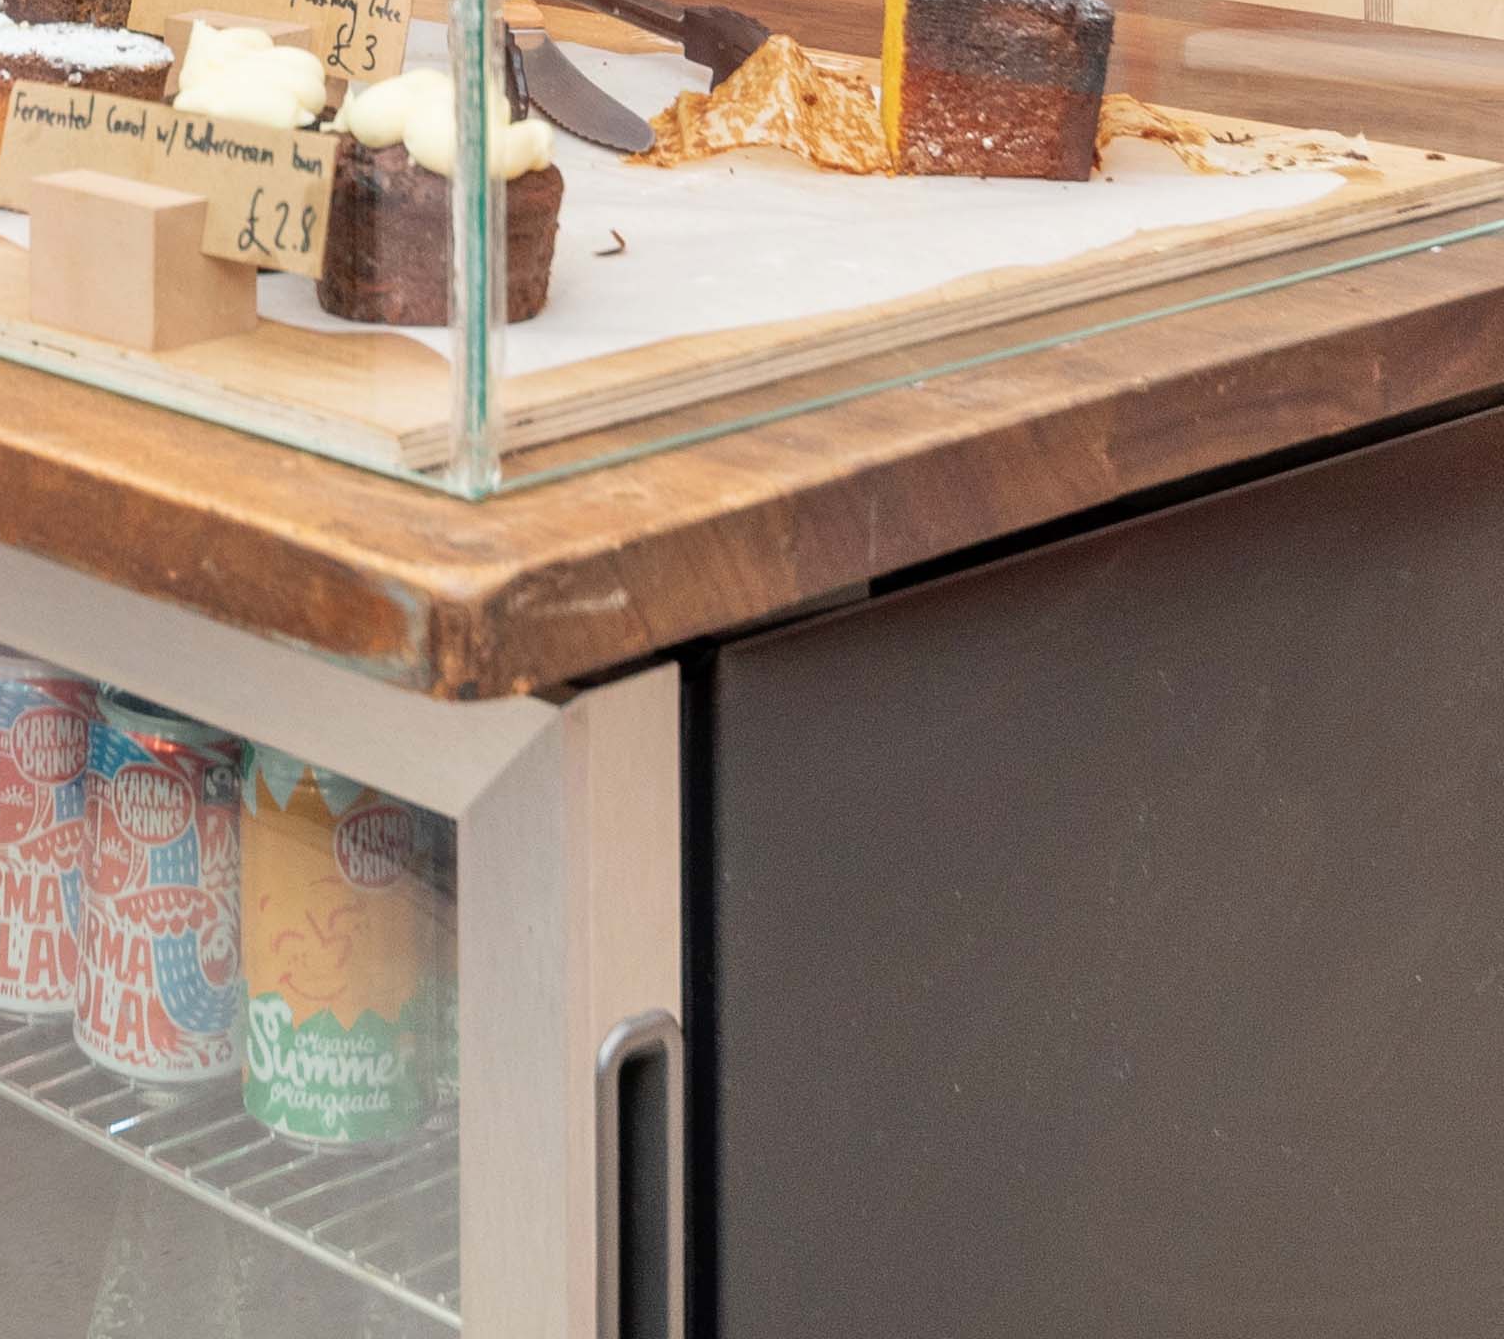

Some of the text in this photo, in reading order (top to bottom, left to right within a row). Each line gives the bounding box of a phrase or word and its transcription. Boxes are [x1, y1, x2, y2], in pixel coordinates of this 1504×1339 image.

[13, 89, 96, 129] Fermented
[237, 186, 318, 256] £2.8
[14, 715, 85, 753] KARMA
[22, 744, 86, 778] DRINKS
[117, 769, 185, 810] KARMA
[120, 805, 186, 839] DRINKS
[294, 1030, 376, 1062] organic
